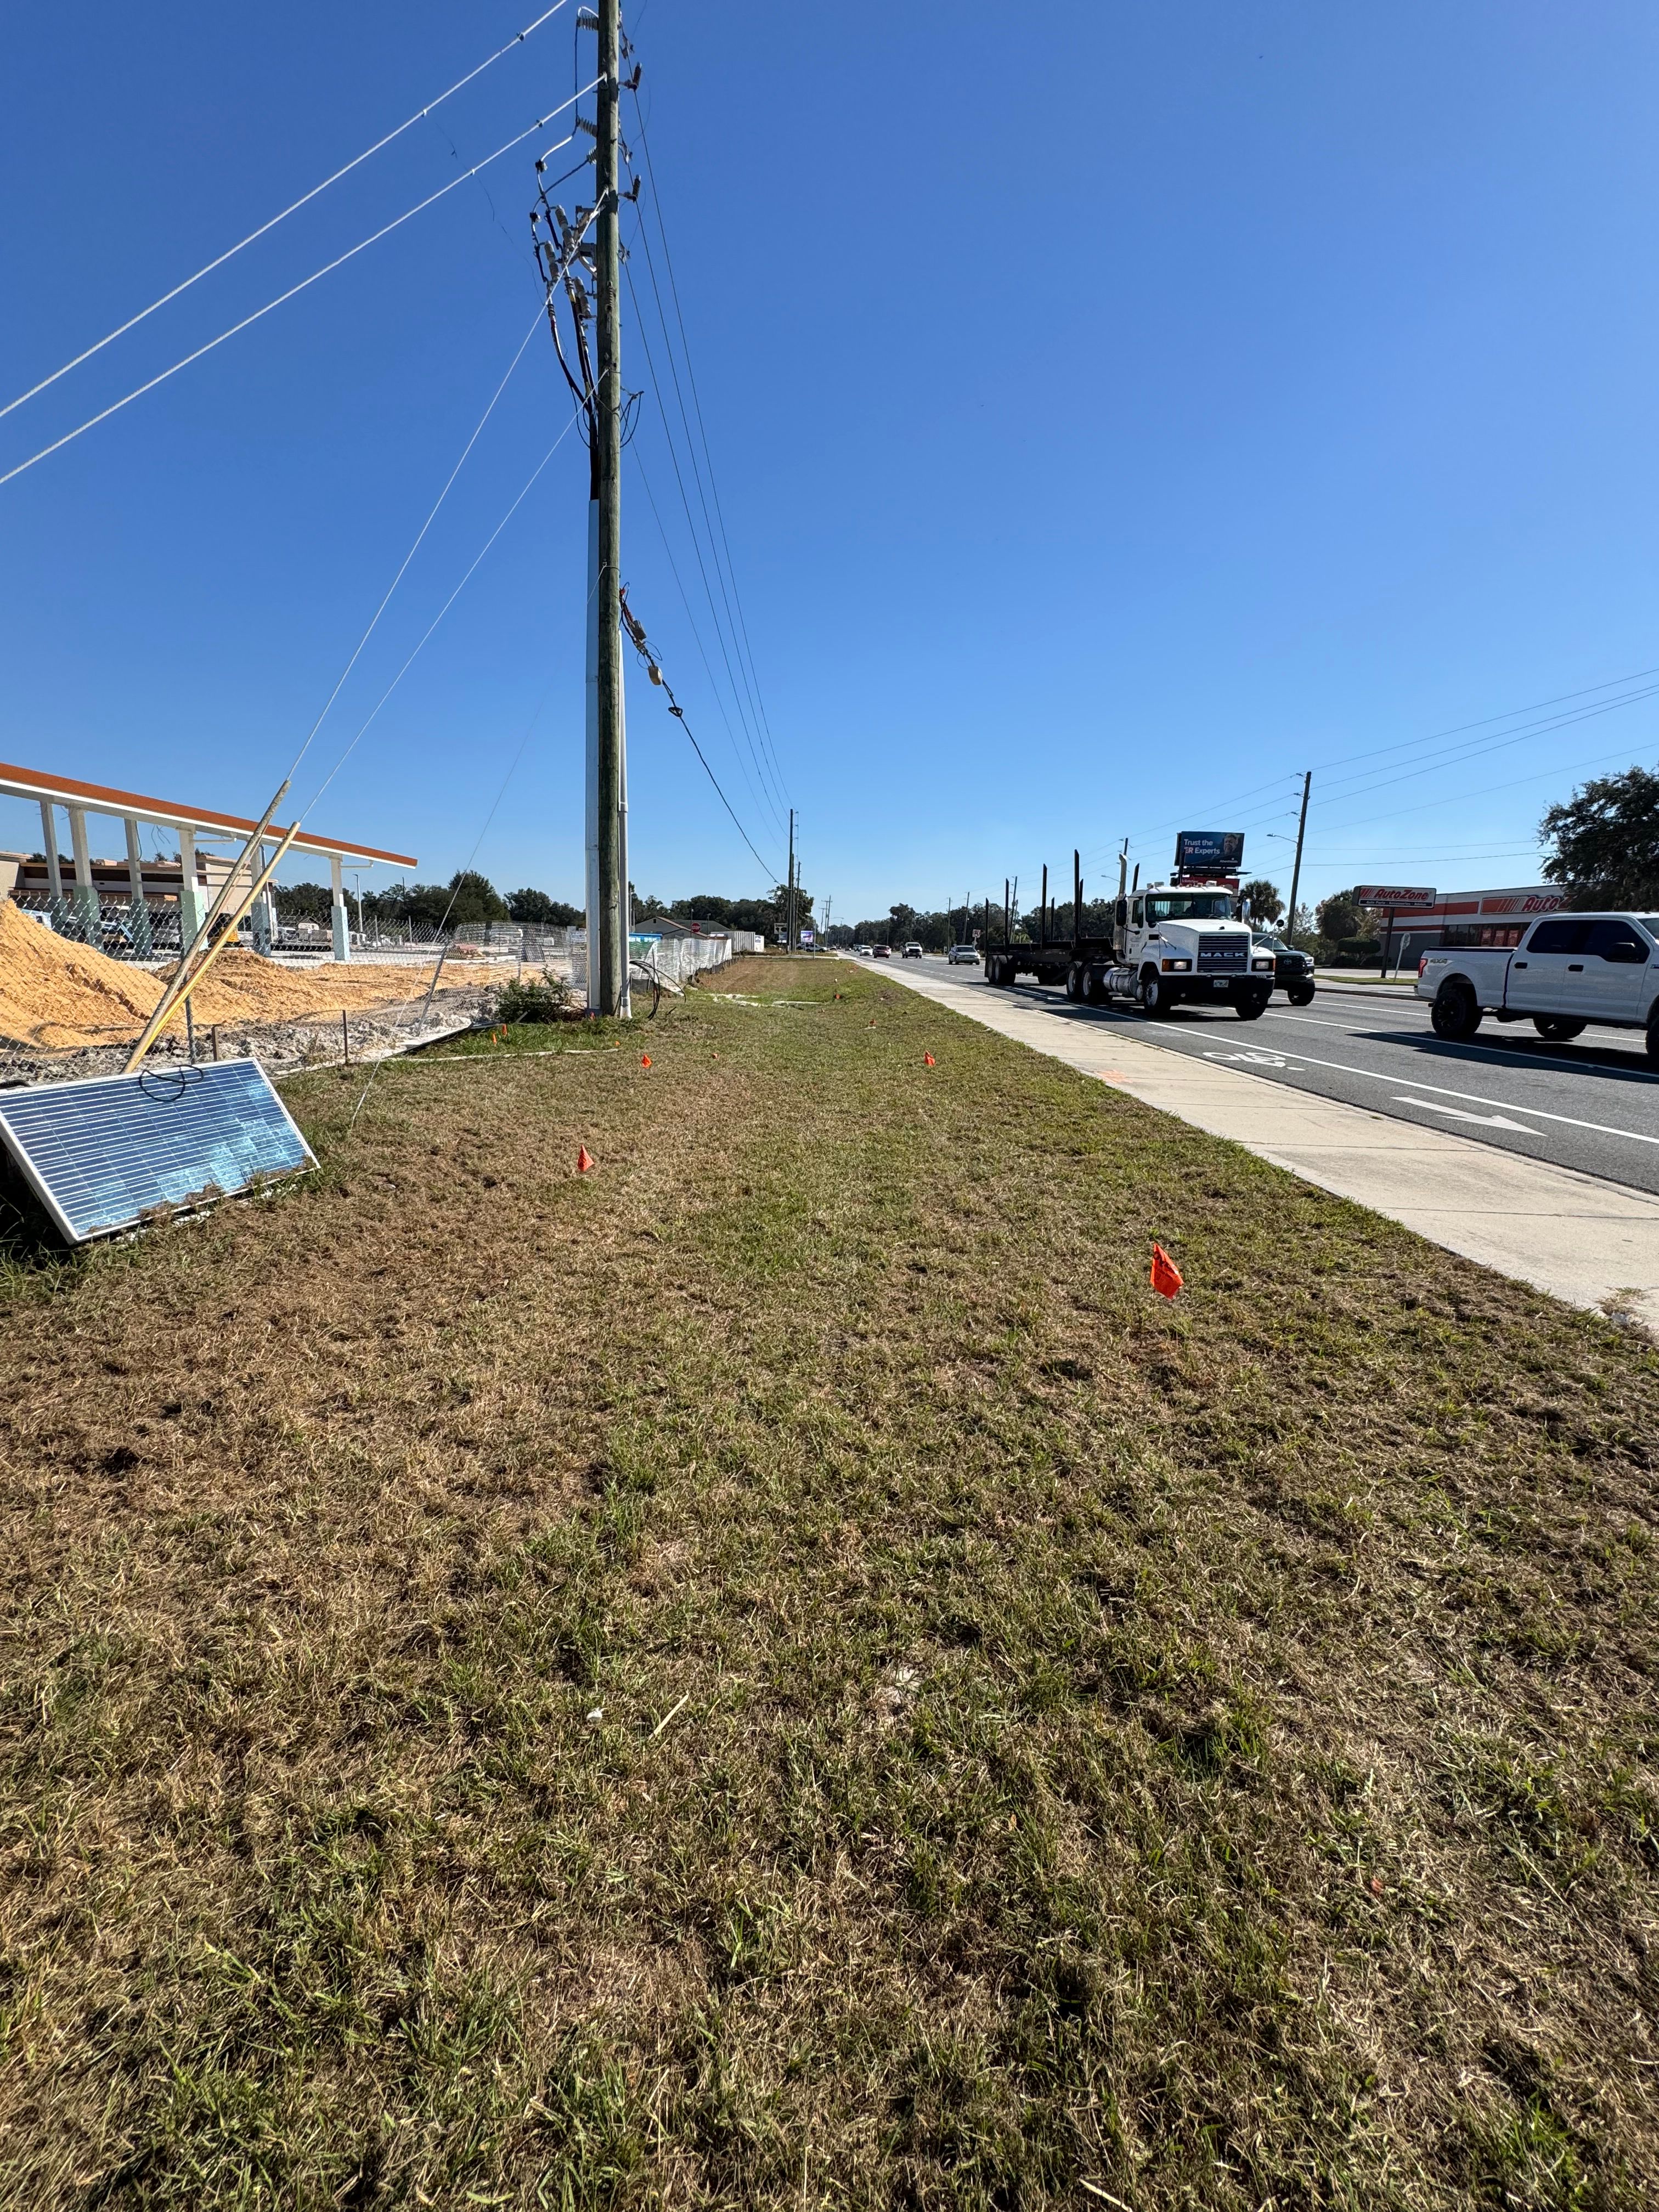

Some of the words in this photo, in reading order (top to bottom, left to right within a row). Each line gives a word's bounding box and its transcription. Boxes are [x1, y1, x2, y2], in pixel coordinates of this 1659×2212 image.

[1194, 847, 1220, 855] Experts
[1373, 888, 1429, 901] AutoZone
[1521, 893, 1578, 912] AutoZ
